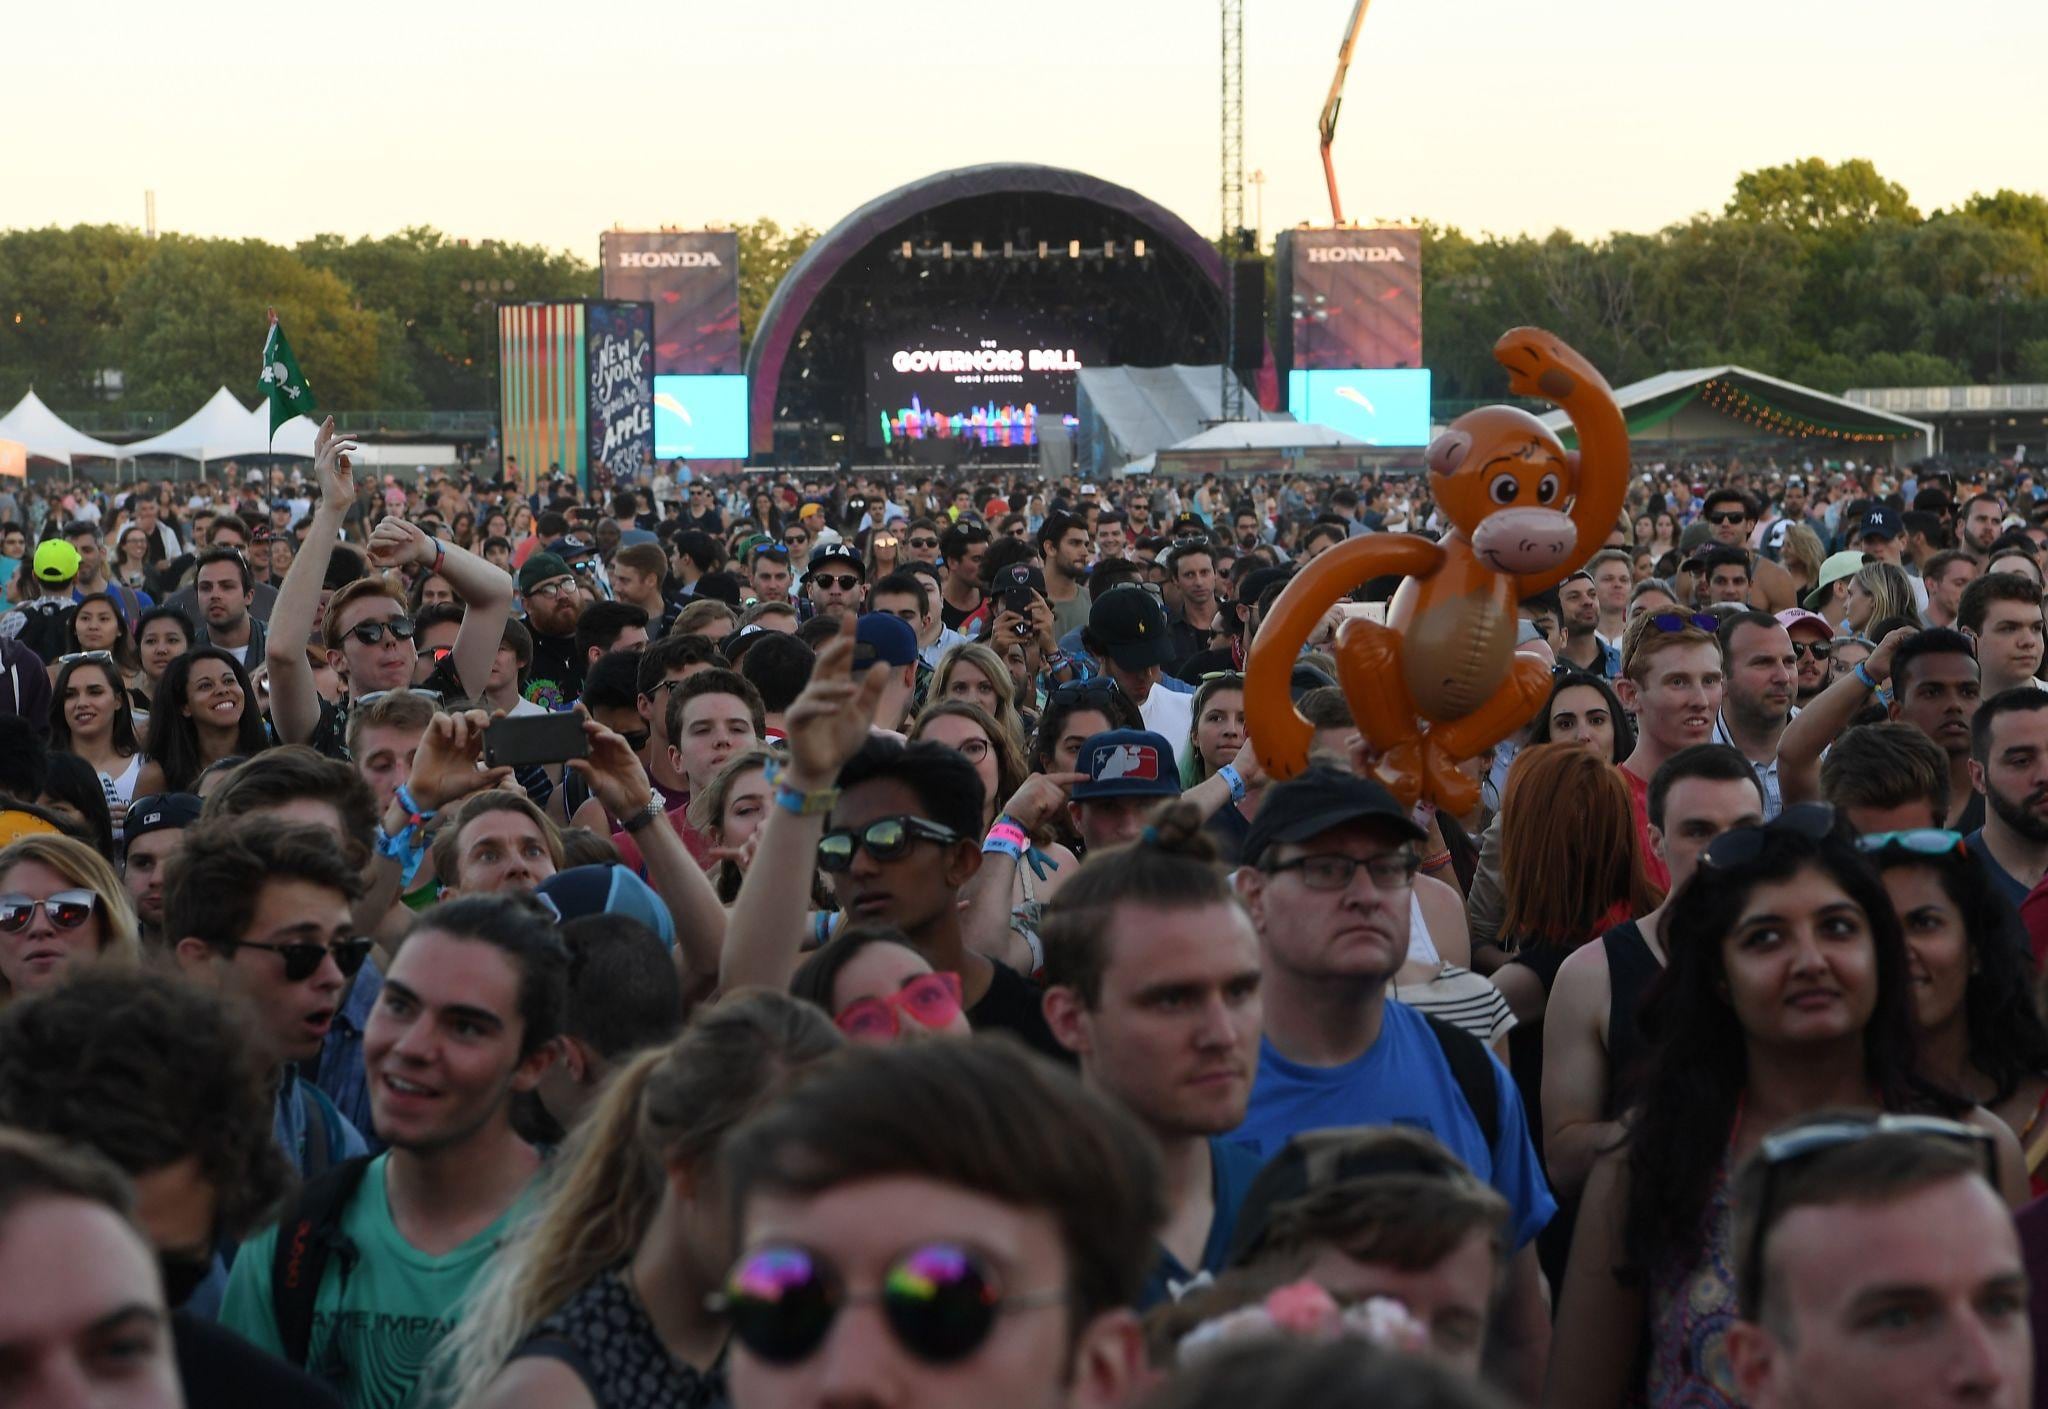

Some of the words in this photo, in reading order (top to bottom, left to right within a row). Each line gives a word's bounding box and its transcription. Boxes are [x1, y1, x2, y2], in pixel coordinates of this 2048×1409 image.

[619, 252, 722, 268] HONDA
[1308, 246, 1406, 263] HONDA
[592, 334, 630, 388] NEW
[599, 342, 650, 403] YORK
[892, 349, 1024, 373] GOVERNORS
[1029, 349, 1082, 371] BALL
[600, 404, 651, 463] APPLE
[825, 544, 851, 557] LA
[374, 1312, 457, 1335] IMPA
